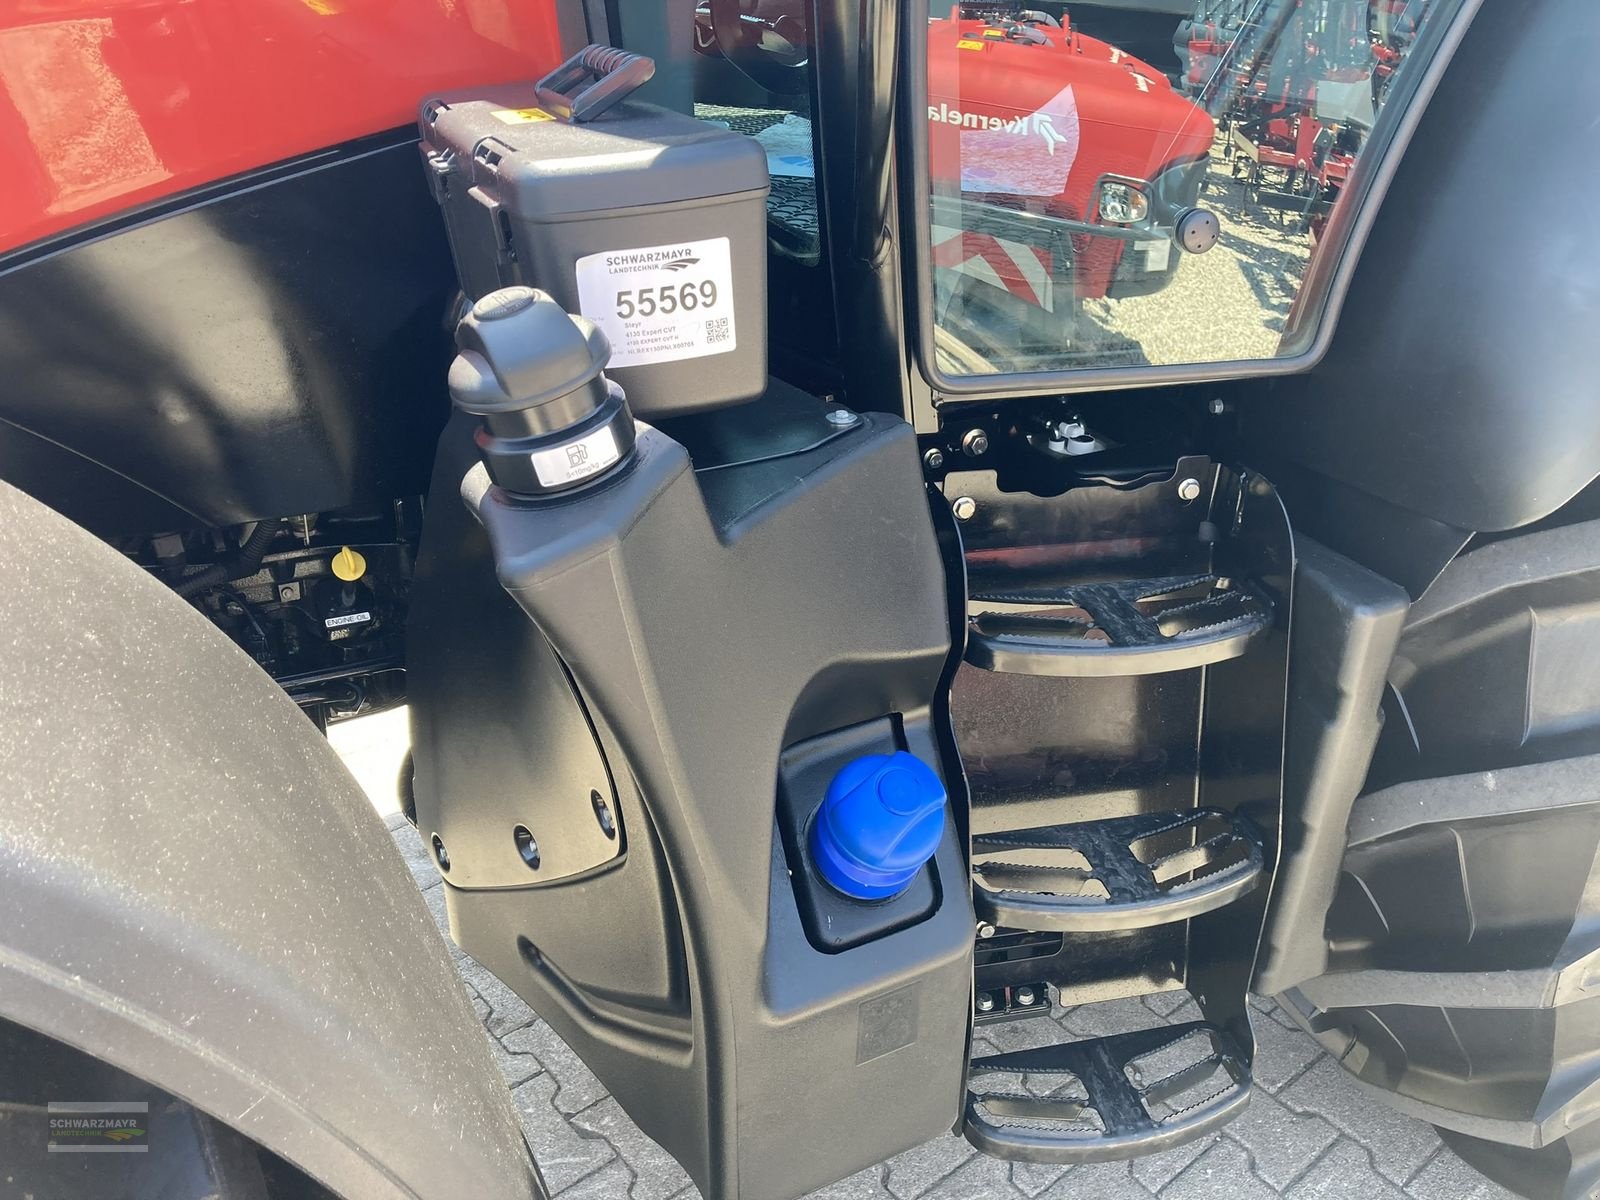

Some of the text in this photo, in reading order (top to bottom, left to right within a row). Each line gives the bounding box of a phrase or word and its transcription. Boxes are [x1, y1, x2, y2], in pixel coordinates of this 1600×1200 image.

[606, 248, 692, 266] SCHWARZMAYR
[609, 263, 660, 274] LANDTECHNIK
[616, 279, 717, 319] 55569
[624, 321, 641, 329] Steyr
[662, 326, 676, 334] CVT
[327, 613, 370, 627] ENGINE OIL
